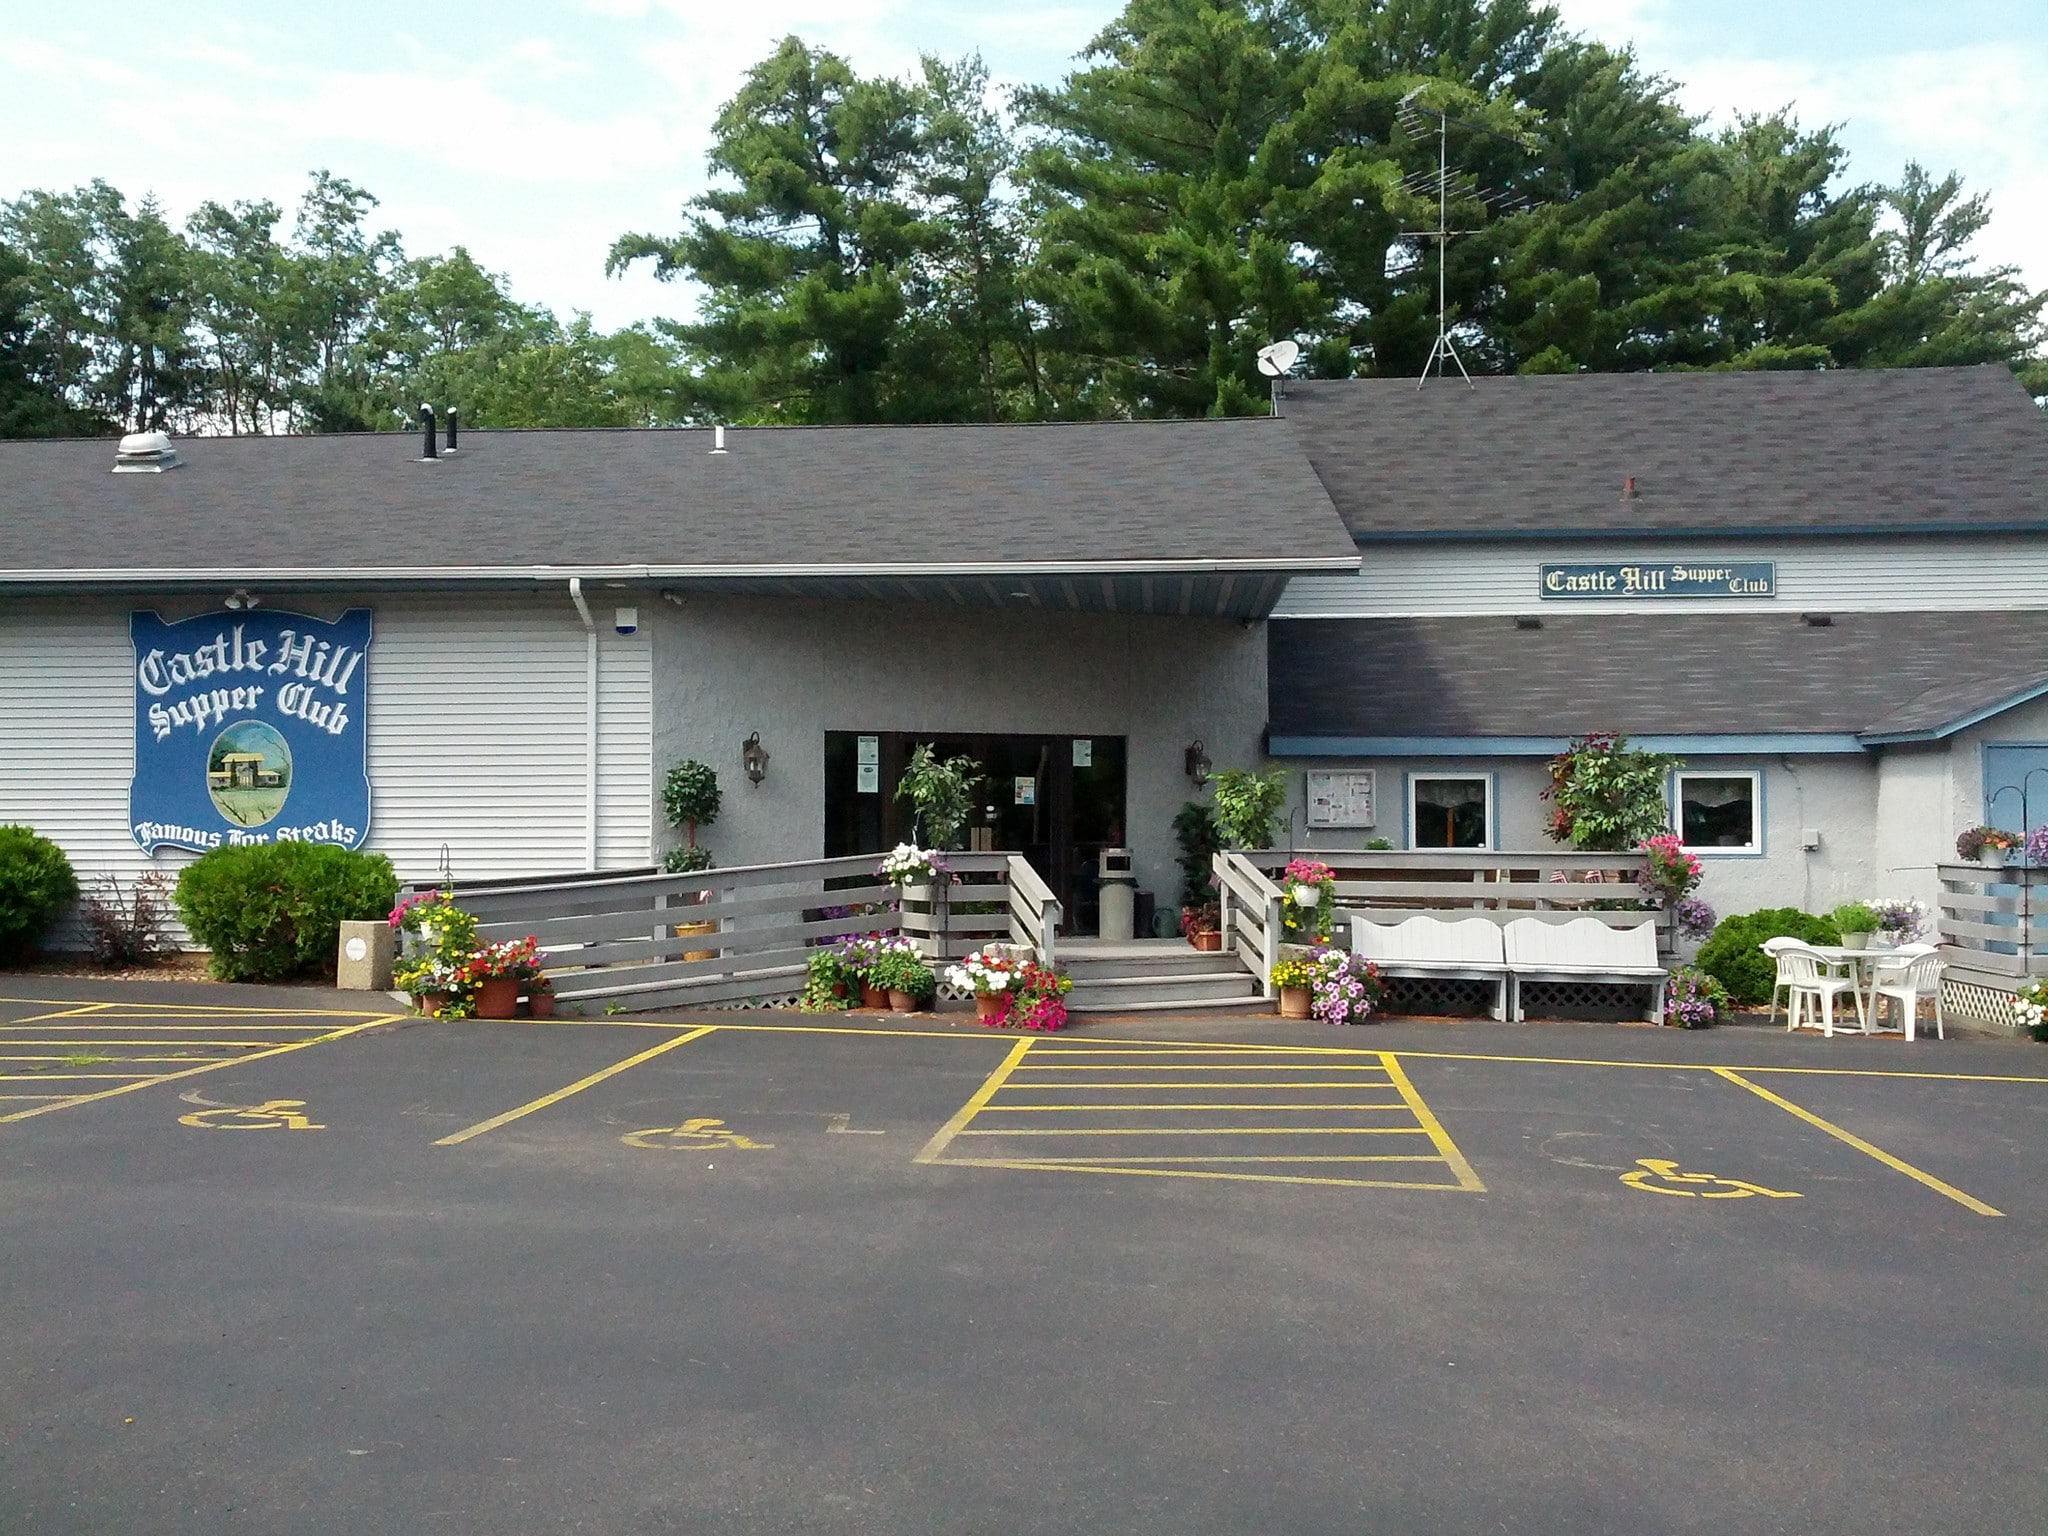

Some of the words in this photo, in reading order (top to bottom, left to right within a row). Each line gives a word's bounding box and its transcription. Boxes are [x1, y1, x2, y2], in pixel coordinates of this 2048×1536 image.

[1546, 570, 1616, 592] Castle
[1620, 566, 1666, 595] Hill
[1671, 565, 1733, 582] Supper
[1729, 577, 1768, 593] Club
[139, 623, 268, 695] Castle
[267, 629, 364, 695] Hill
[149, 684, 264, 743] Supper
[277, 682, 350, 735] Club
[134, 821, 222, 848] Famous
[226, 829, 270, 846] For
[276, 818, 358, 844] Steaks
